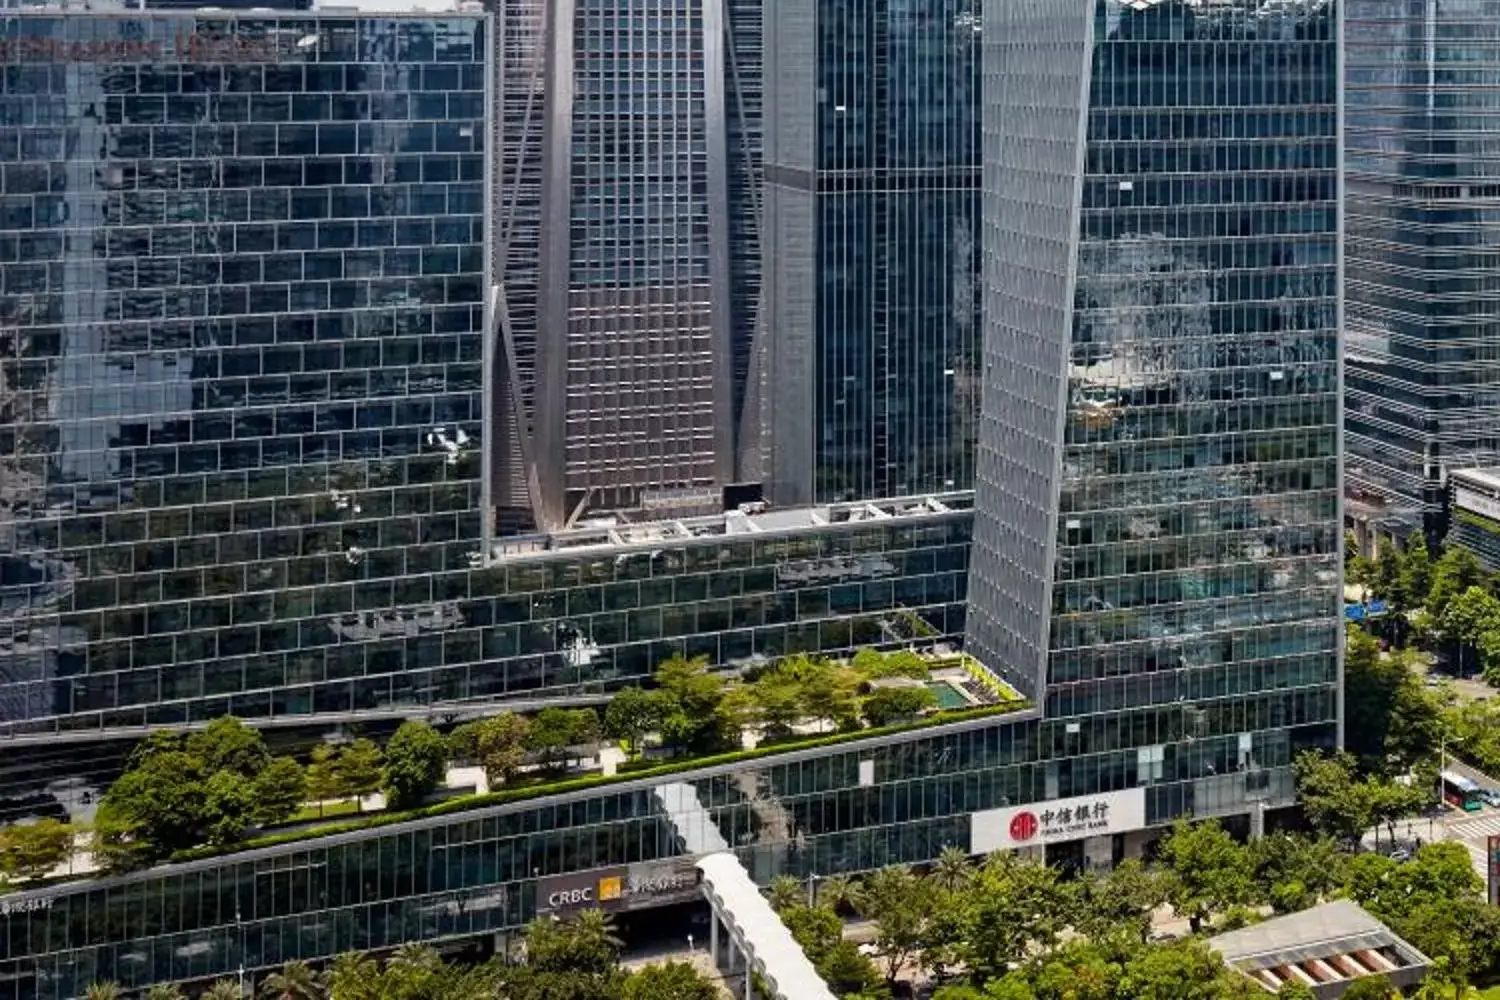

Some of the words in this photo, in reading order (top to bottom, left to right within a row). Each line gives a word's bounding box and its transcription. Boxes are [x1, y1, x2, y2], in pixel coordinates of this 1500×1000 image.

[1040, 801, 1109, 827] 中信银行
[549, 887, 593, 906] CRBC
